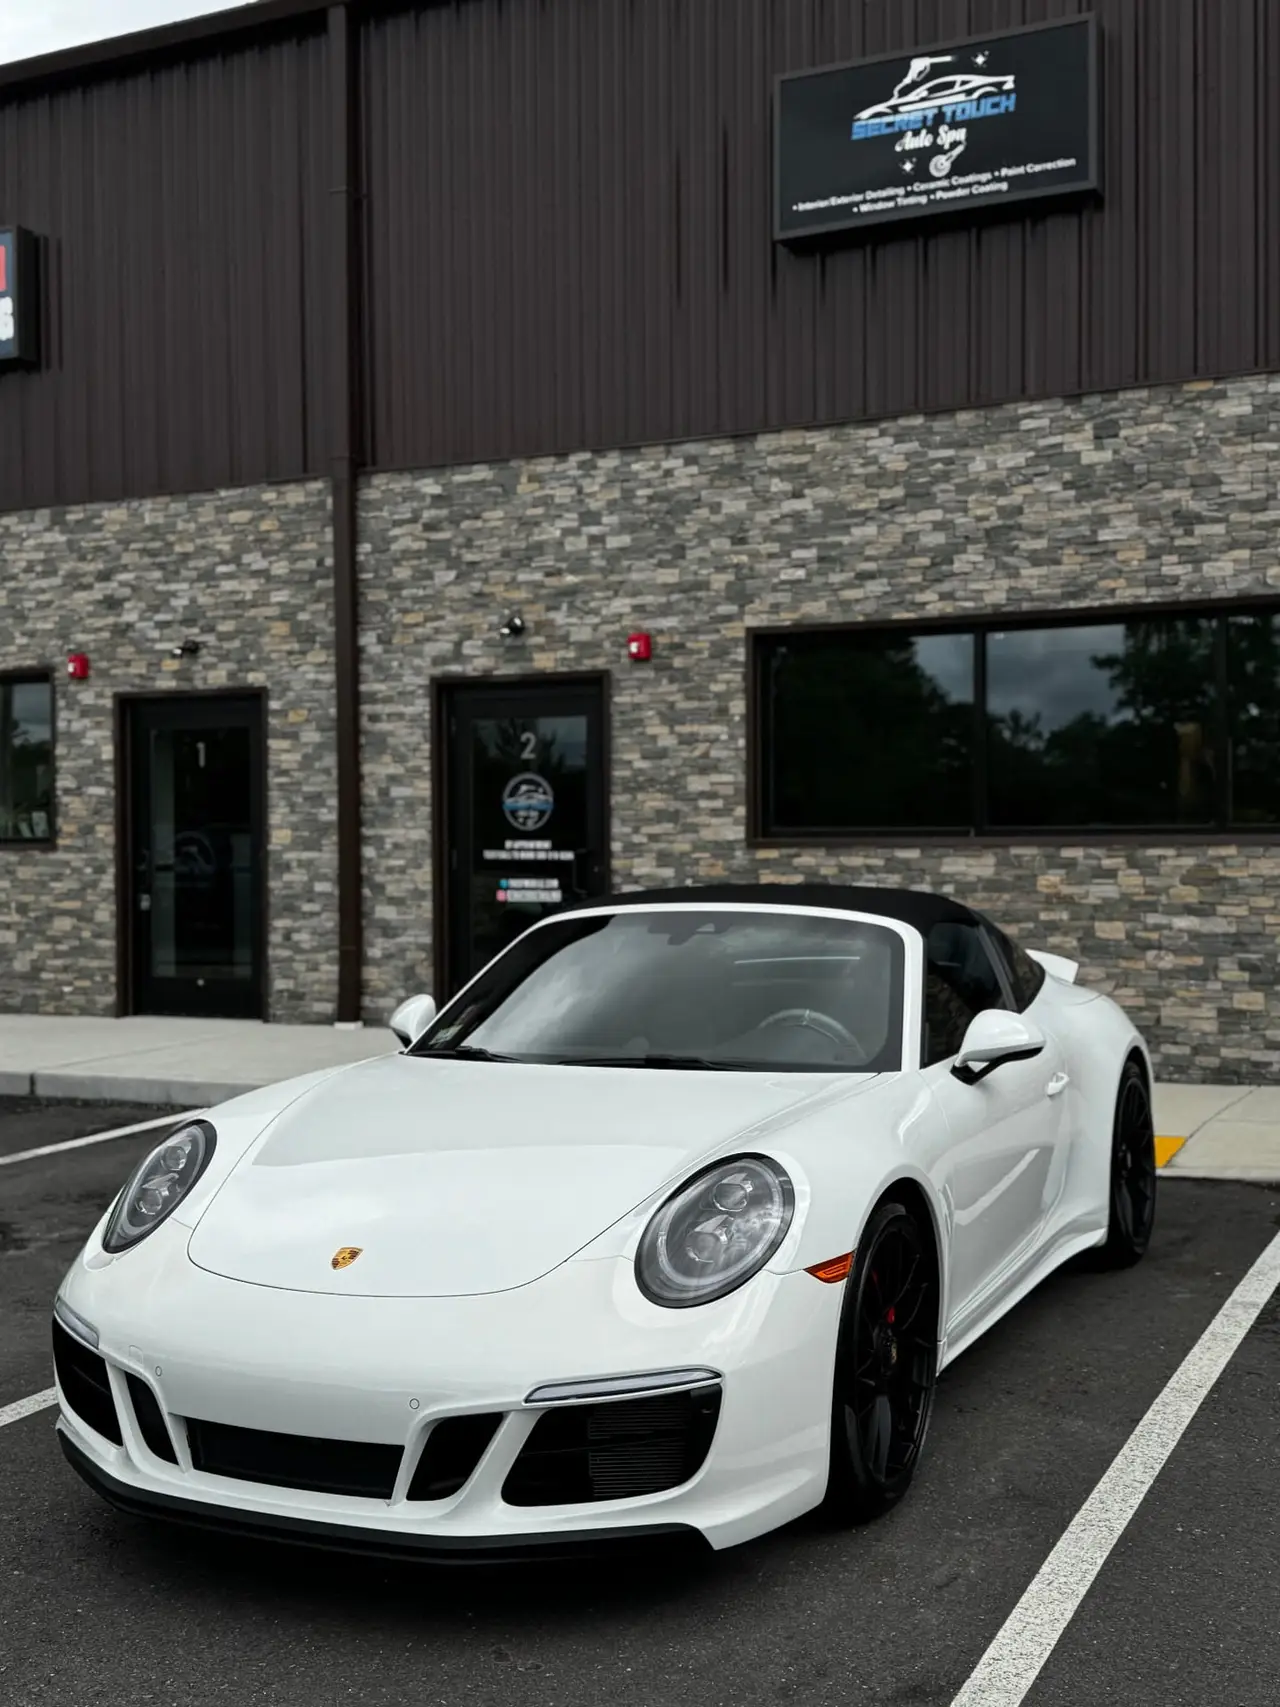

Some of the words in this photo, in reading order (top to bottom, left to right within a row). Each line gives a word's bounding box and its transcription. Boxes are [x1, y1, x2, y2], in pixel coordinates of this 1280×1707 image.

[851, 108, 938, 140] SECRET
[942, 93, 1017, 123] TOUCH
[895, 129, 934, 152] Auto
[936, 124, 967, 150] Spa
[912, 178, 950, 192] Ceramic
[951, 172, 993, 186] Coatings
[1000, 164, 1025, 177] Paint
[1025, 158, 1077, 174] Correction
[971, 181, 1009, 195] Coating
[196, 741, 206, 768] 1
[520, 732, 536, 760] 2
